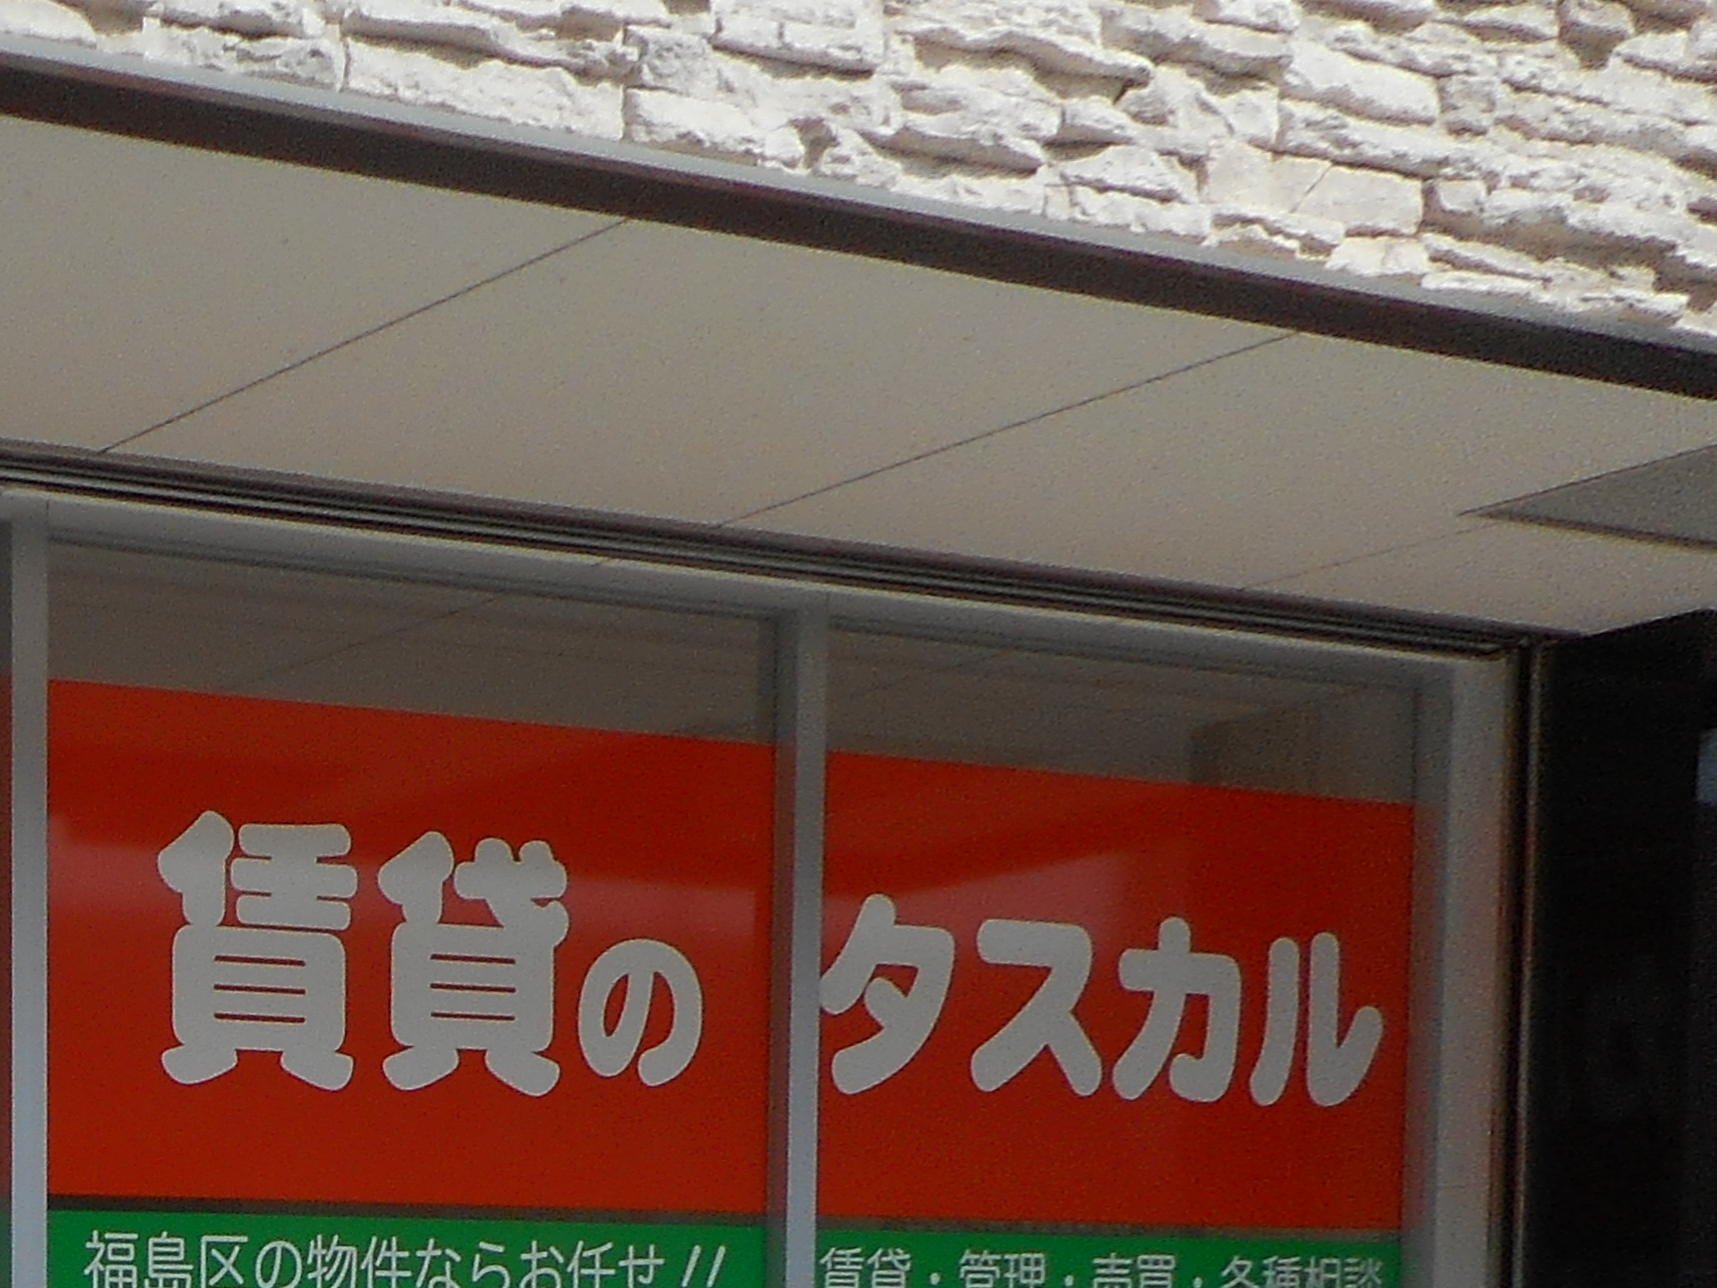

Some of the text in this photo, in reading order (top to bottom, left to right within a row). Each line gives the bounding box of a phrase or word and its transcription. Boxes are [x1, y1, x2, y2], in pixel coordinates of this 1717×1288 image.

[157, 809, 1384, 1107] 賃貸の タスカル
